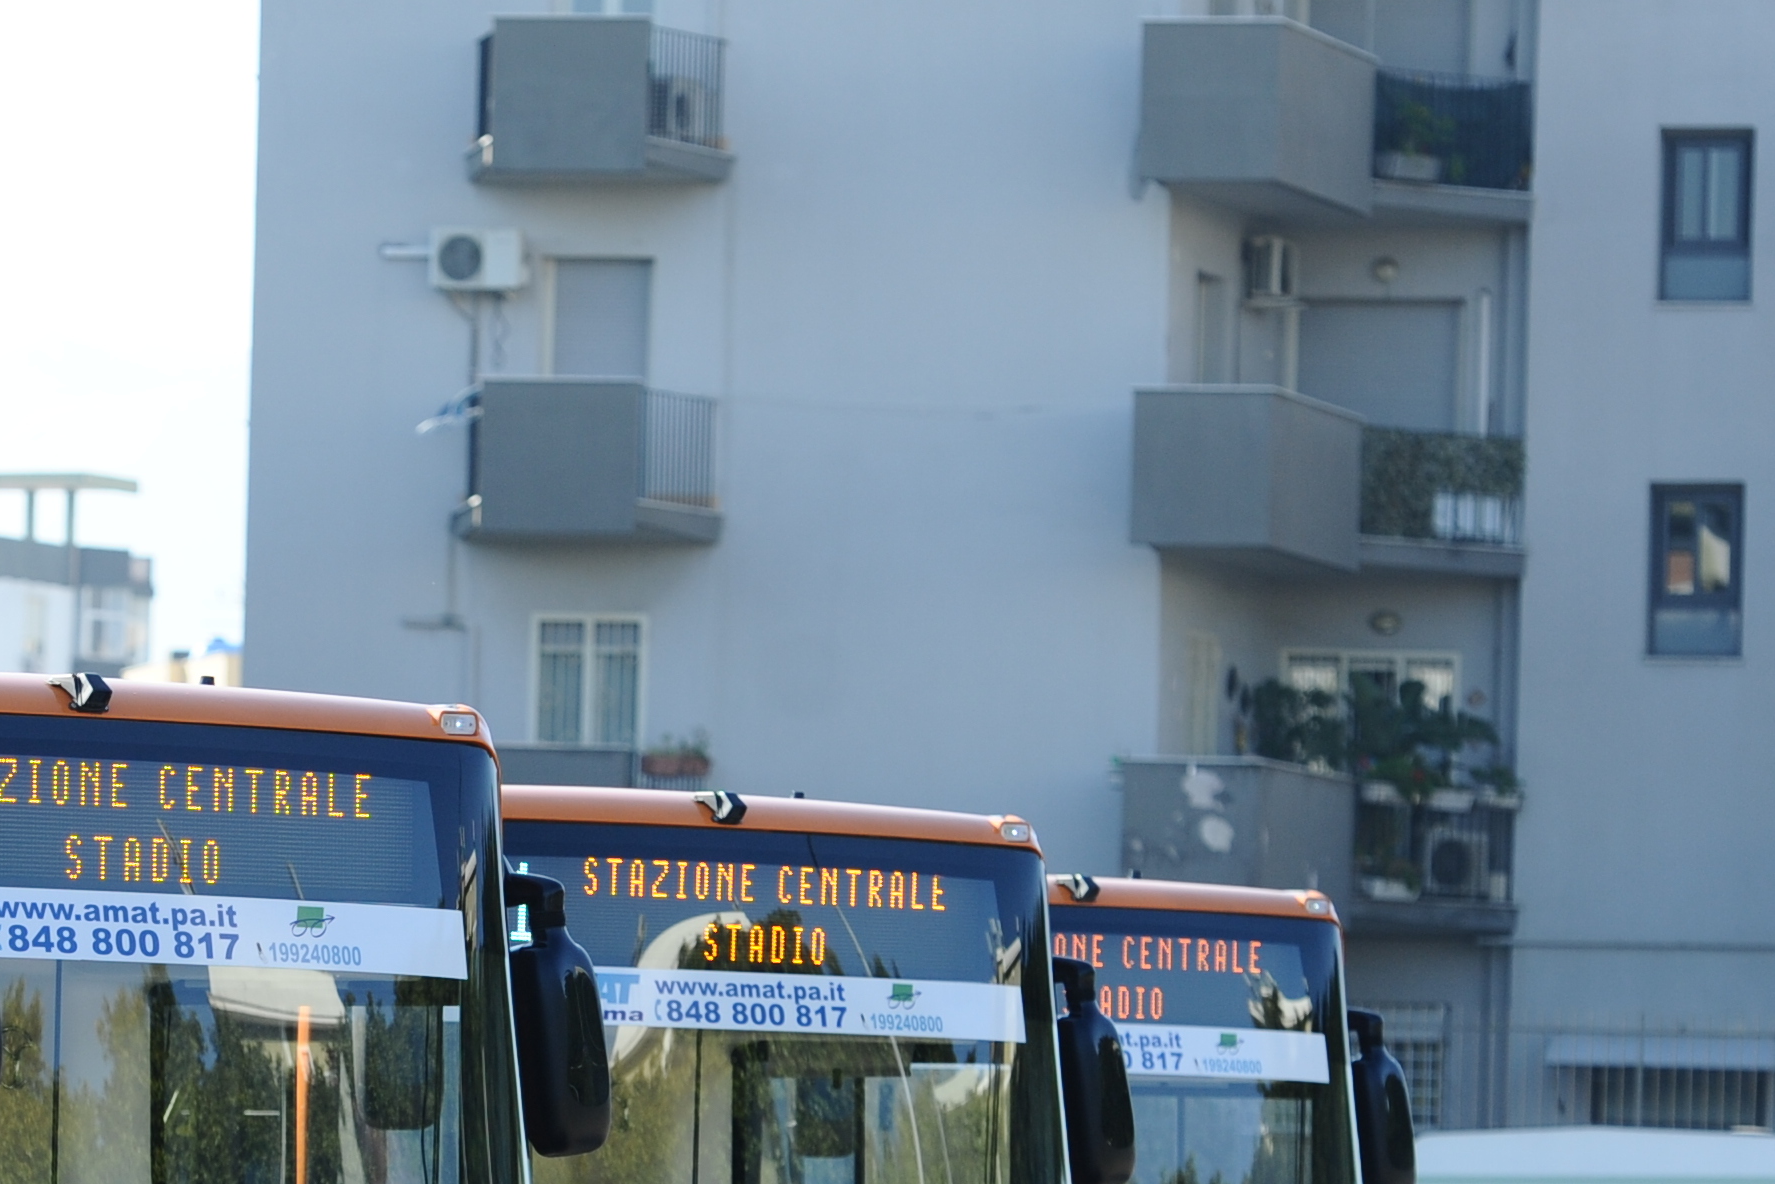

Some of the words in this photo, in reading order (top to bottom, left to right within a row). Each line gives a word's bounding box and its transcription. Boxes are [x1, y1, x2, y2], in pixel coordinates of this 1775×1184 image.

[158, 765, 372, 819] CENTRALE
[65, 833, 220, 885] STADIO
[583, 855, 757, 903] STAZIONE
[777, 864, 947, 912] CENTRALE
[7, 924, 78, 955] 848
[91, 927, 161, 958] 800
[173, 932, 240, 961] 817
[268, 941, 363, 967] 199240800
[702, 921, 827, 967] STADIO
[1121, 935, 1262, 974] CENTRALE
[654, 979, 846, 1006] www.amat.pa.it
[666, 999, 721, 1025] 848
[731, 1001, 786, 1027] 800
[795, 1004, 848, 1029] 817
[870, 1011, 944, 1033] 199240800
[1141, 1050, 1184, 1071] 817
